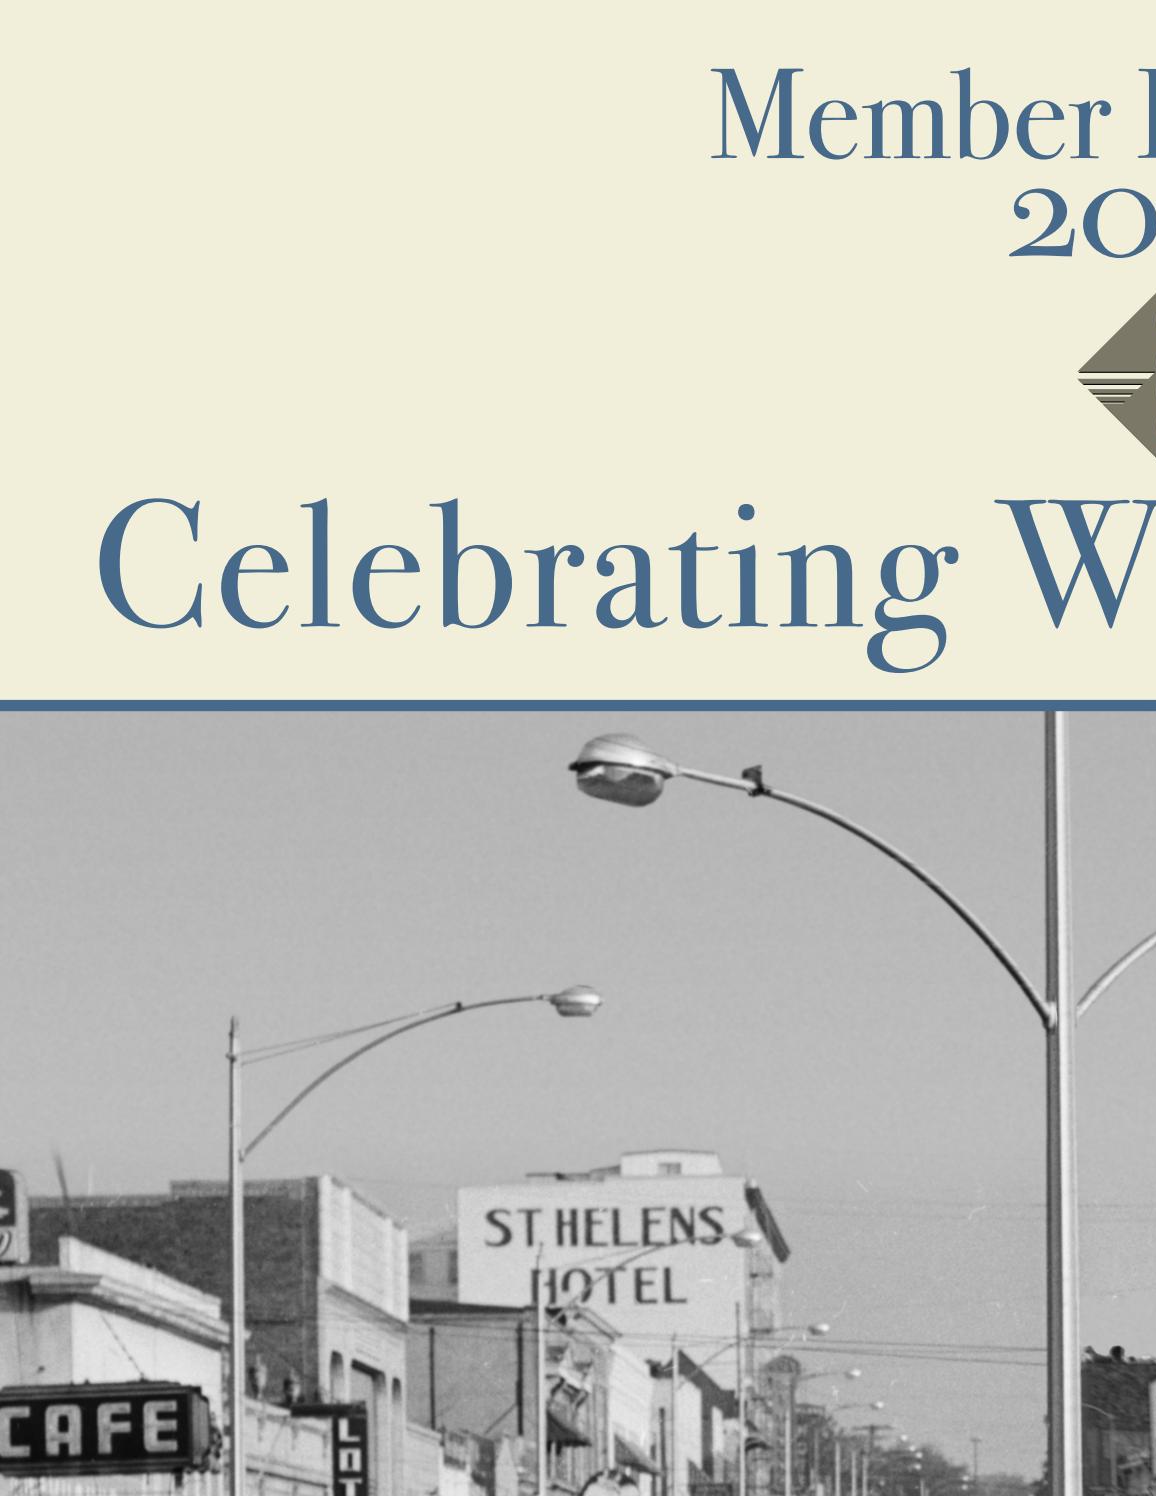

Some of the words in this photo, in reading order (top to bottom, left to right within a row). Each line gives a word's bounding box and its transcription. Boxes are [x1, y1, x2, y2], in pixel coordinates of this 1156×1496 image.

[555, 1206, 725, 1248] HELENS
[530, 1266, 688, 1305] HOTEL
[0, 1400, 179, 1457] CAFE
